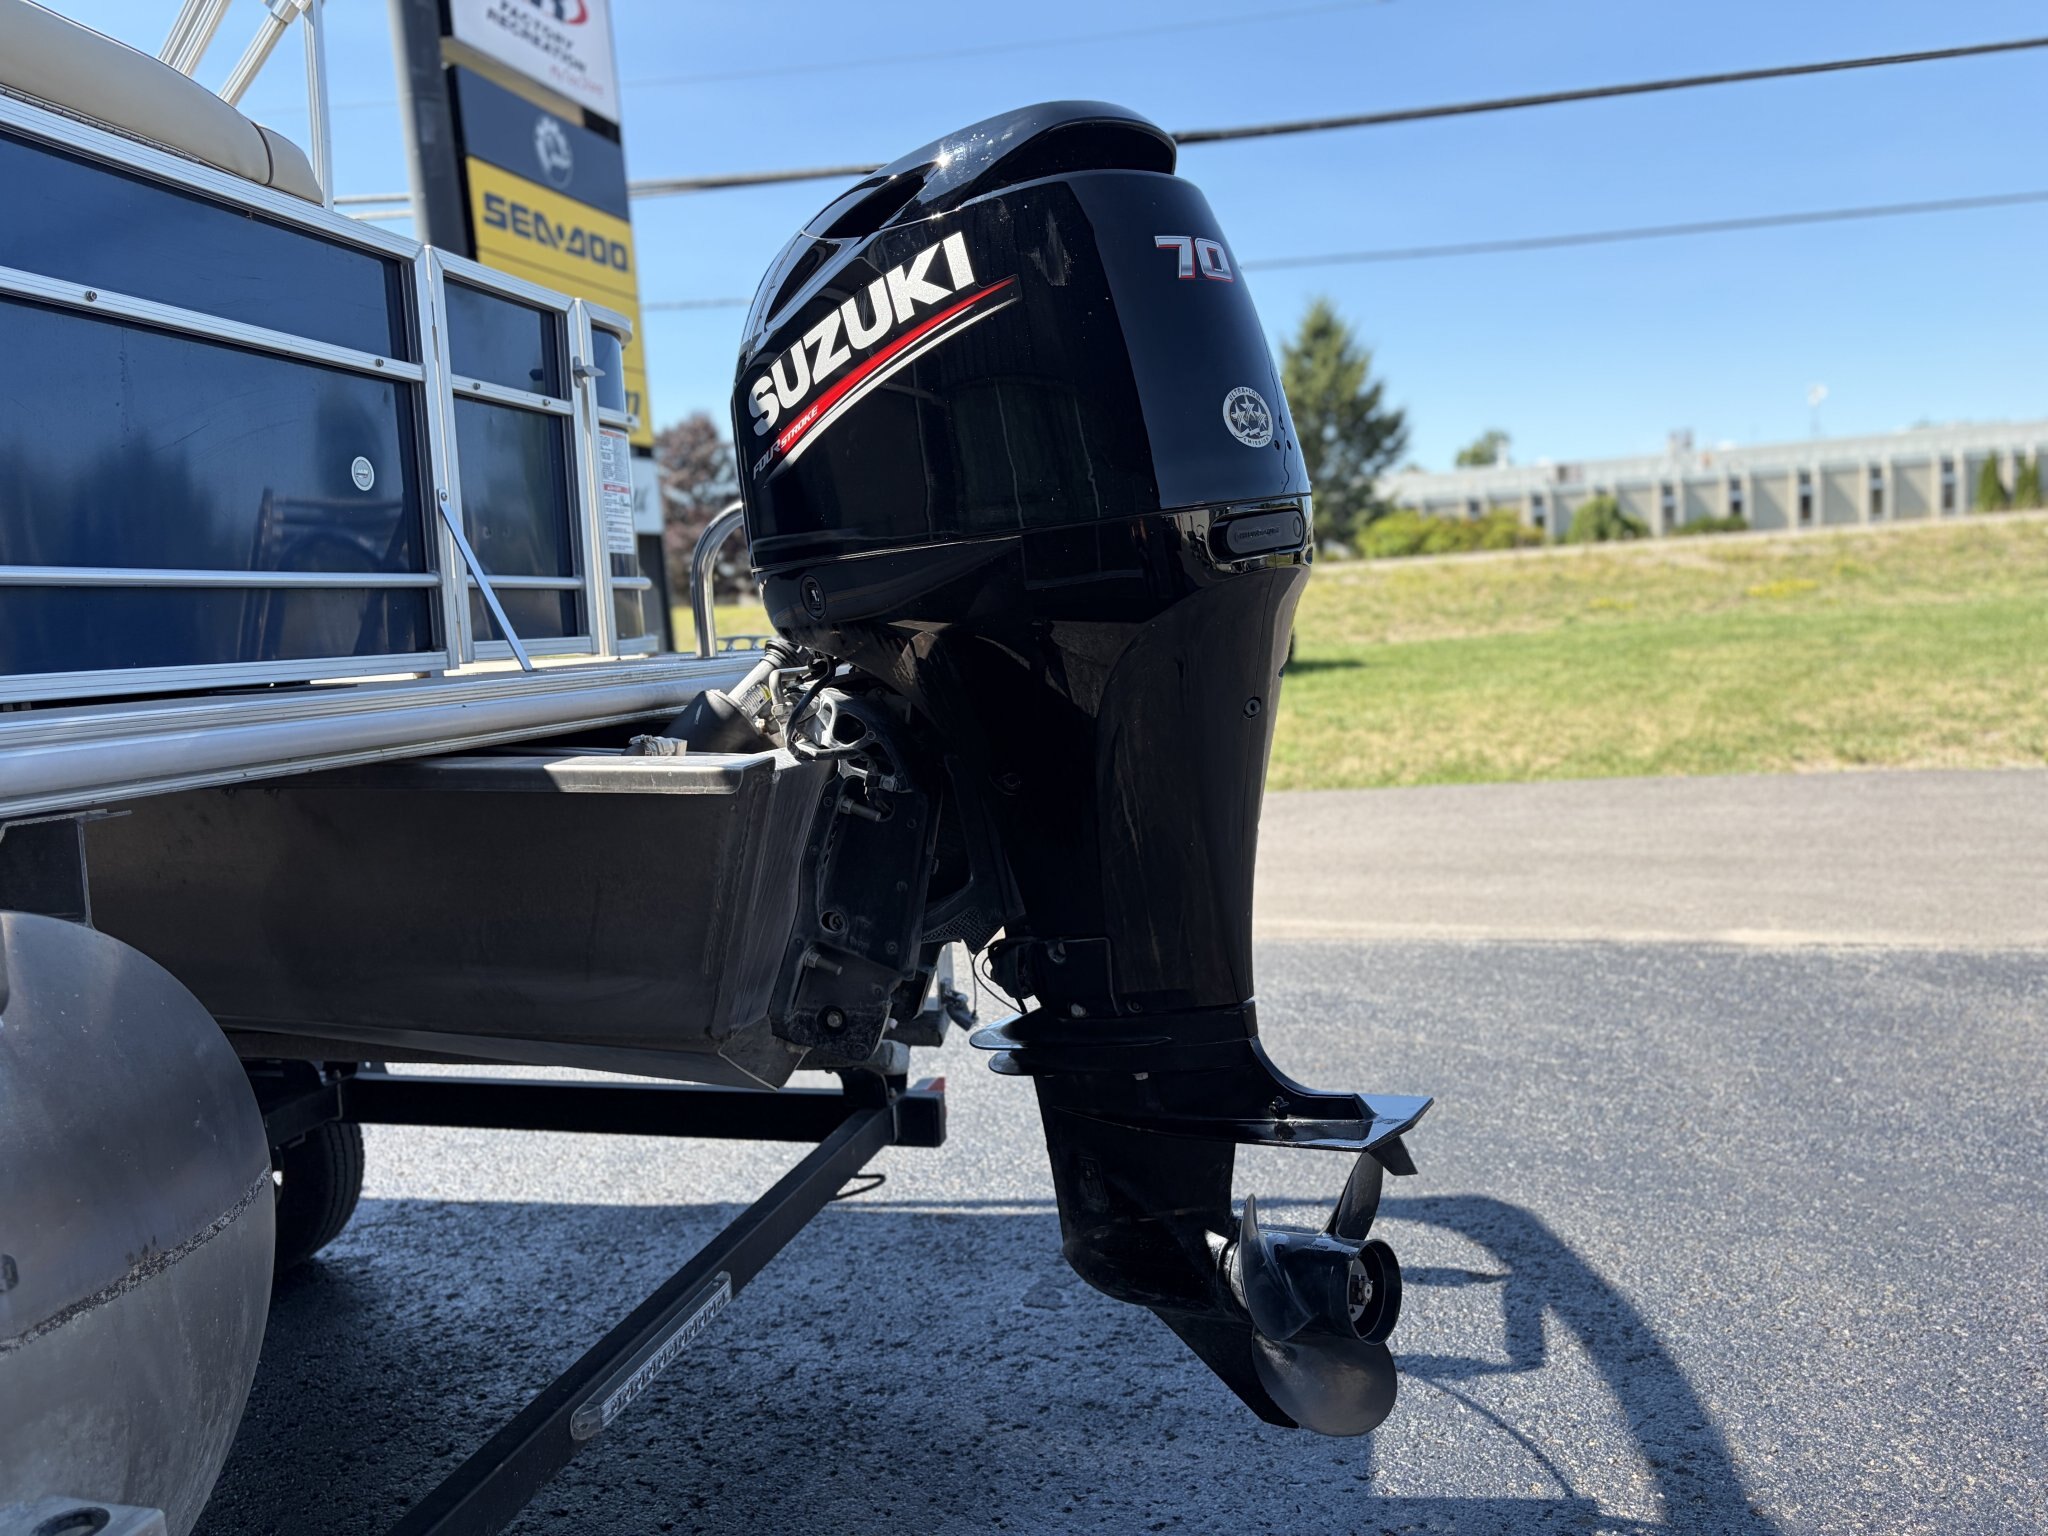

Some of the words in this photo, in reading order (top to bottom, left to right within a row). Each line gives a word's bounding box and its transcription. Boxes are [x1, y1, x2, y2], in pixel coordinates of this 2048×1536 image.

[1154, 236, 1234, 282] 70
[749, 231, 975, 436] SUZUKI
[753, 439, 781, 480] FOUR
[780, 405, 818, 449] STROKE
